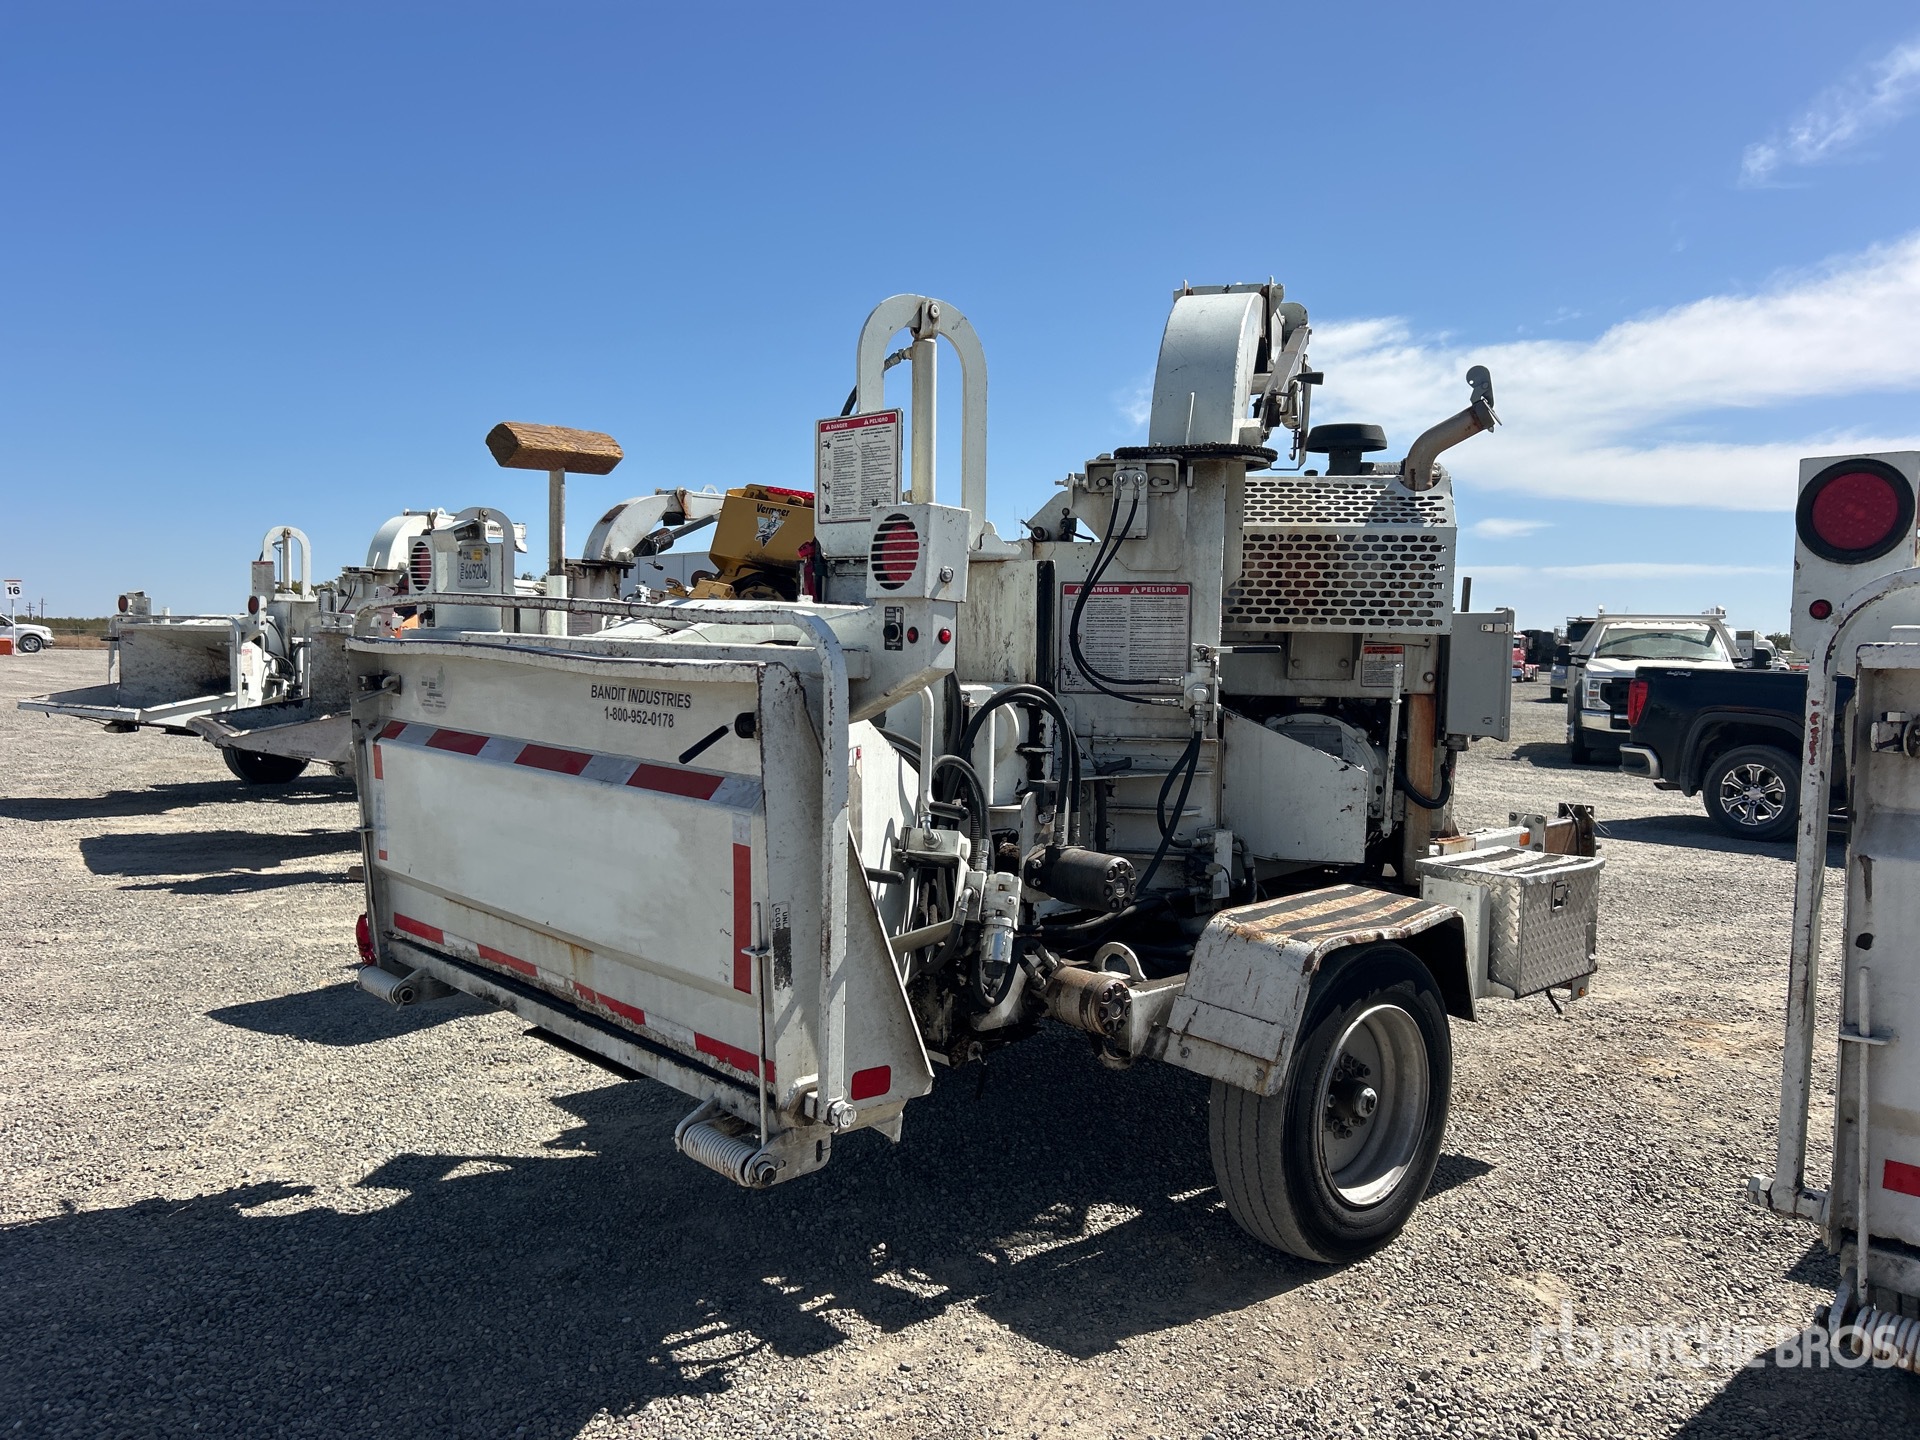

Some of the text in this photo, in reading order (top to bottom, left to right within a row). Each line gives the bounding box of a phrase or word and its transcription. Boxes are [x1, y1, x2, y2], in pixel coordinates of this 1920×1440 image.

[830, 416, 889, 430] DANGER PELIGRO
[465, 563, 488, 580] 669206
[7, 586, 20, 595] 16
[591, 684, 692, 709] BANDIT INDUSTRIES
[604, 707, 674, 728] 1-800-952-0178
